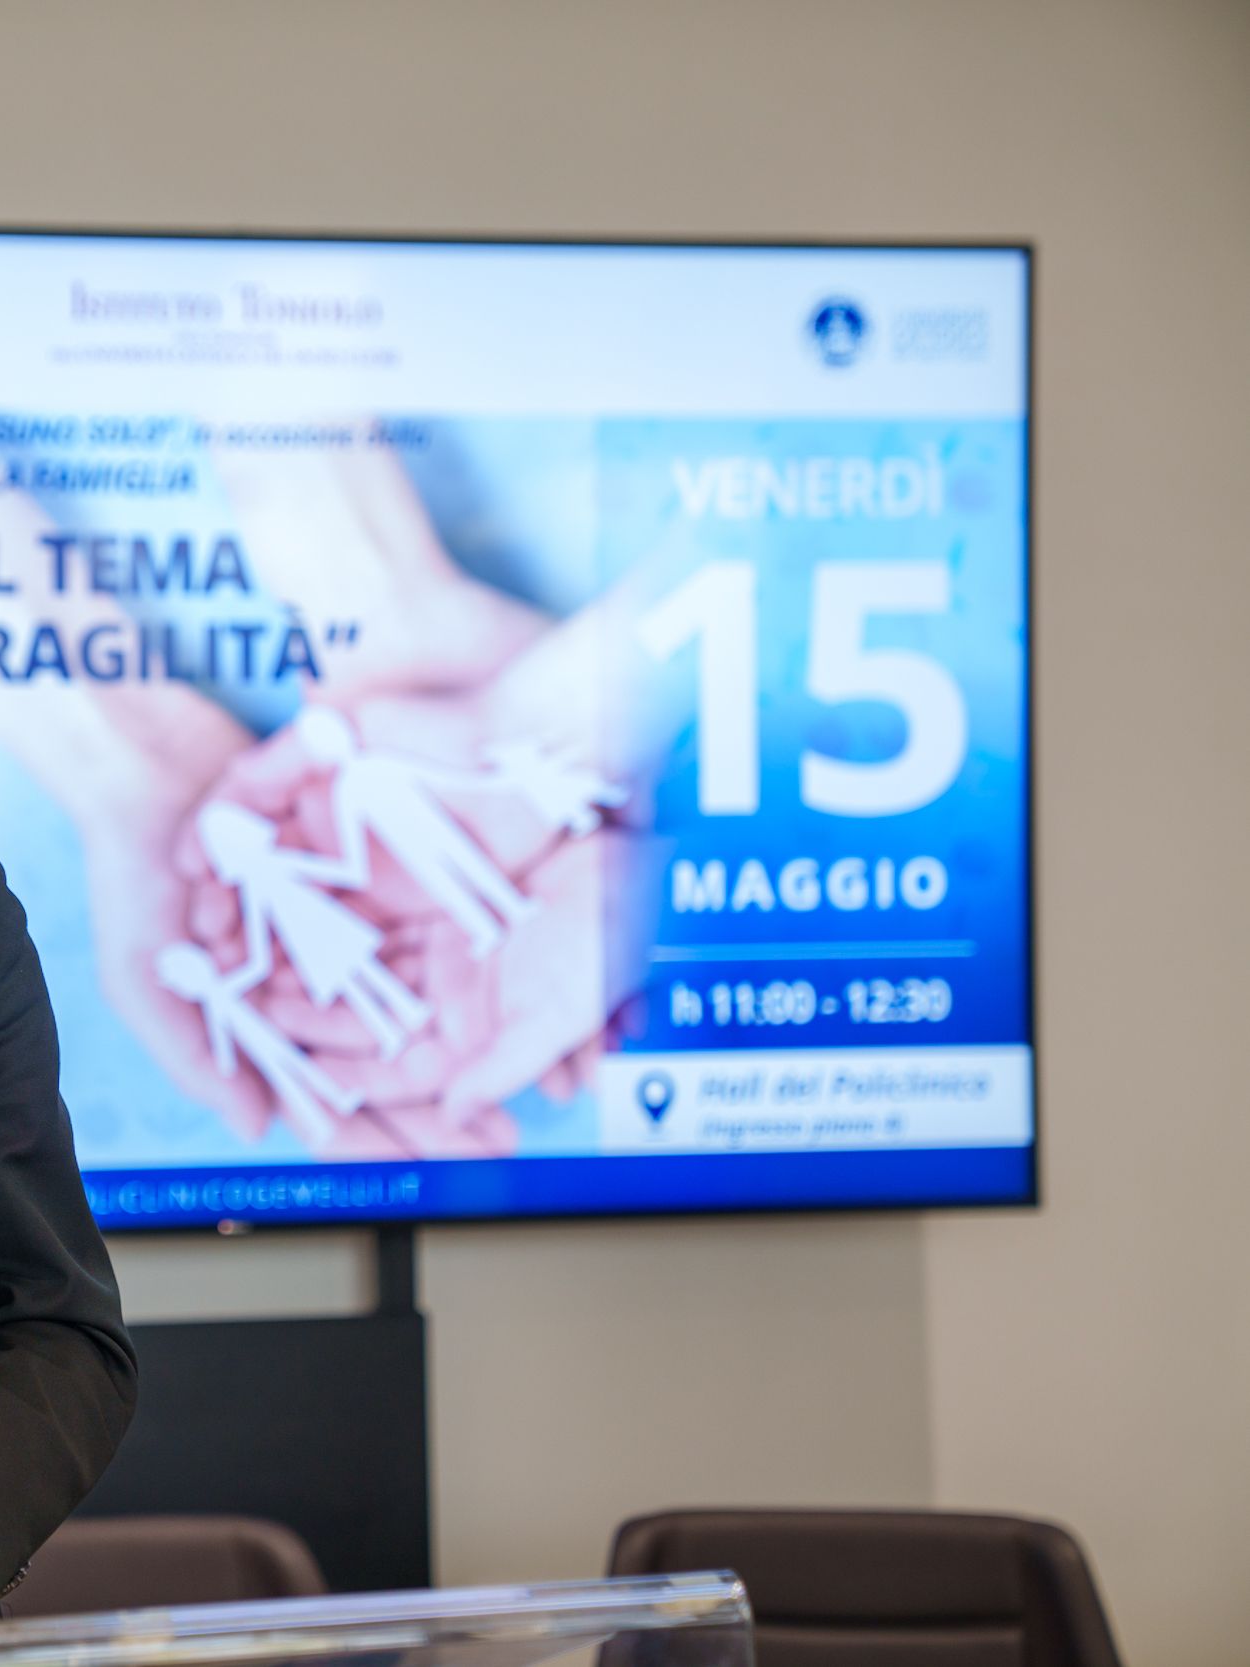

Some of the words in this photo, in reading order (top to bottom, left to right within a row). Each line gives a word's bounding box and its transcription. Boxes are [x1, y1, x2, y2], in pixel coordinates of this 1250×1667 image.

[31, 459, 197, 492] FAMIGLIA
[672, 443, 944, 518] VENERDÌ
[39, 533, 251, 594] TEMA
[638, 559, 968, 818] 15
[672, 857, 948, 912] MAGGIO
[671, 981, 701, 1026] h
[709, 980, 816, 1025] 11:00
[844, 977, 951, 1023] 12:30
